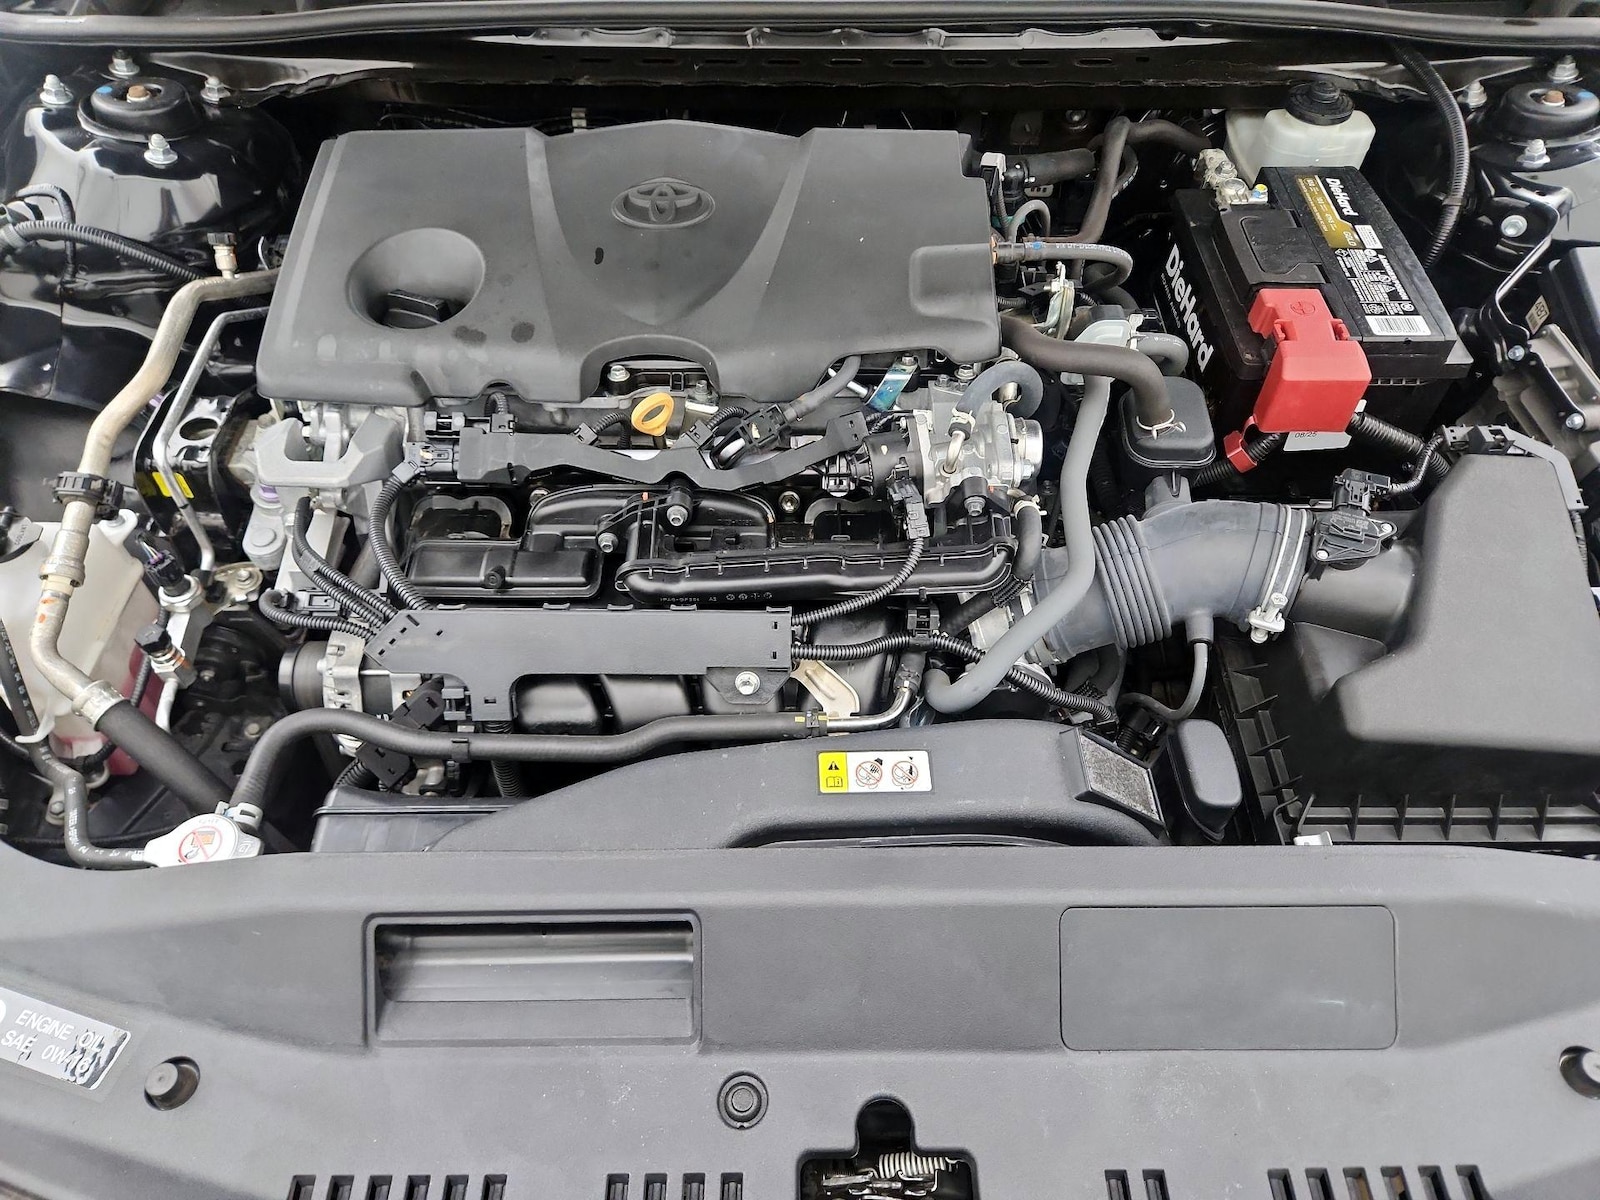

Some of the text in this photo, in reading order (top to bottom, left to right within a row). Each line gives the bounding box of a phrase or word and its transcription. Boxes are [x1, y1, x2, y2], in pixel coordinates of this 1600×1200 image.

[1326, 178, 1359, 216] DieHard
[1343, 231, 1357, 246] GOLD
[1166, 243, 1214, 372] DieHard
[1, 1030, 92, 1074] SAE 0W-16
[15, 1010, 105, 1052] ENGINE OIL
